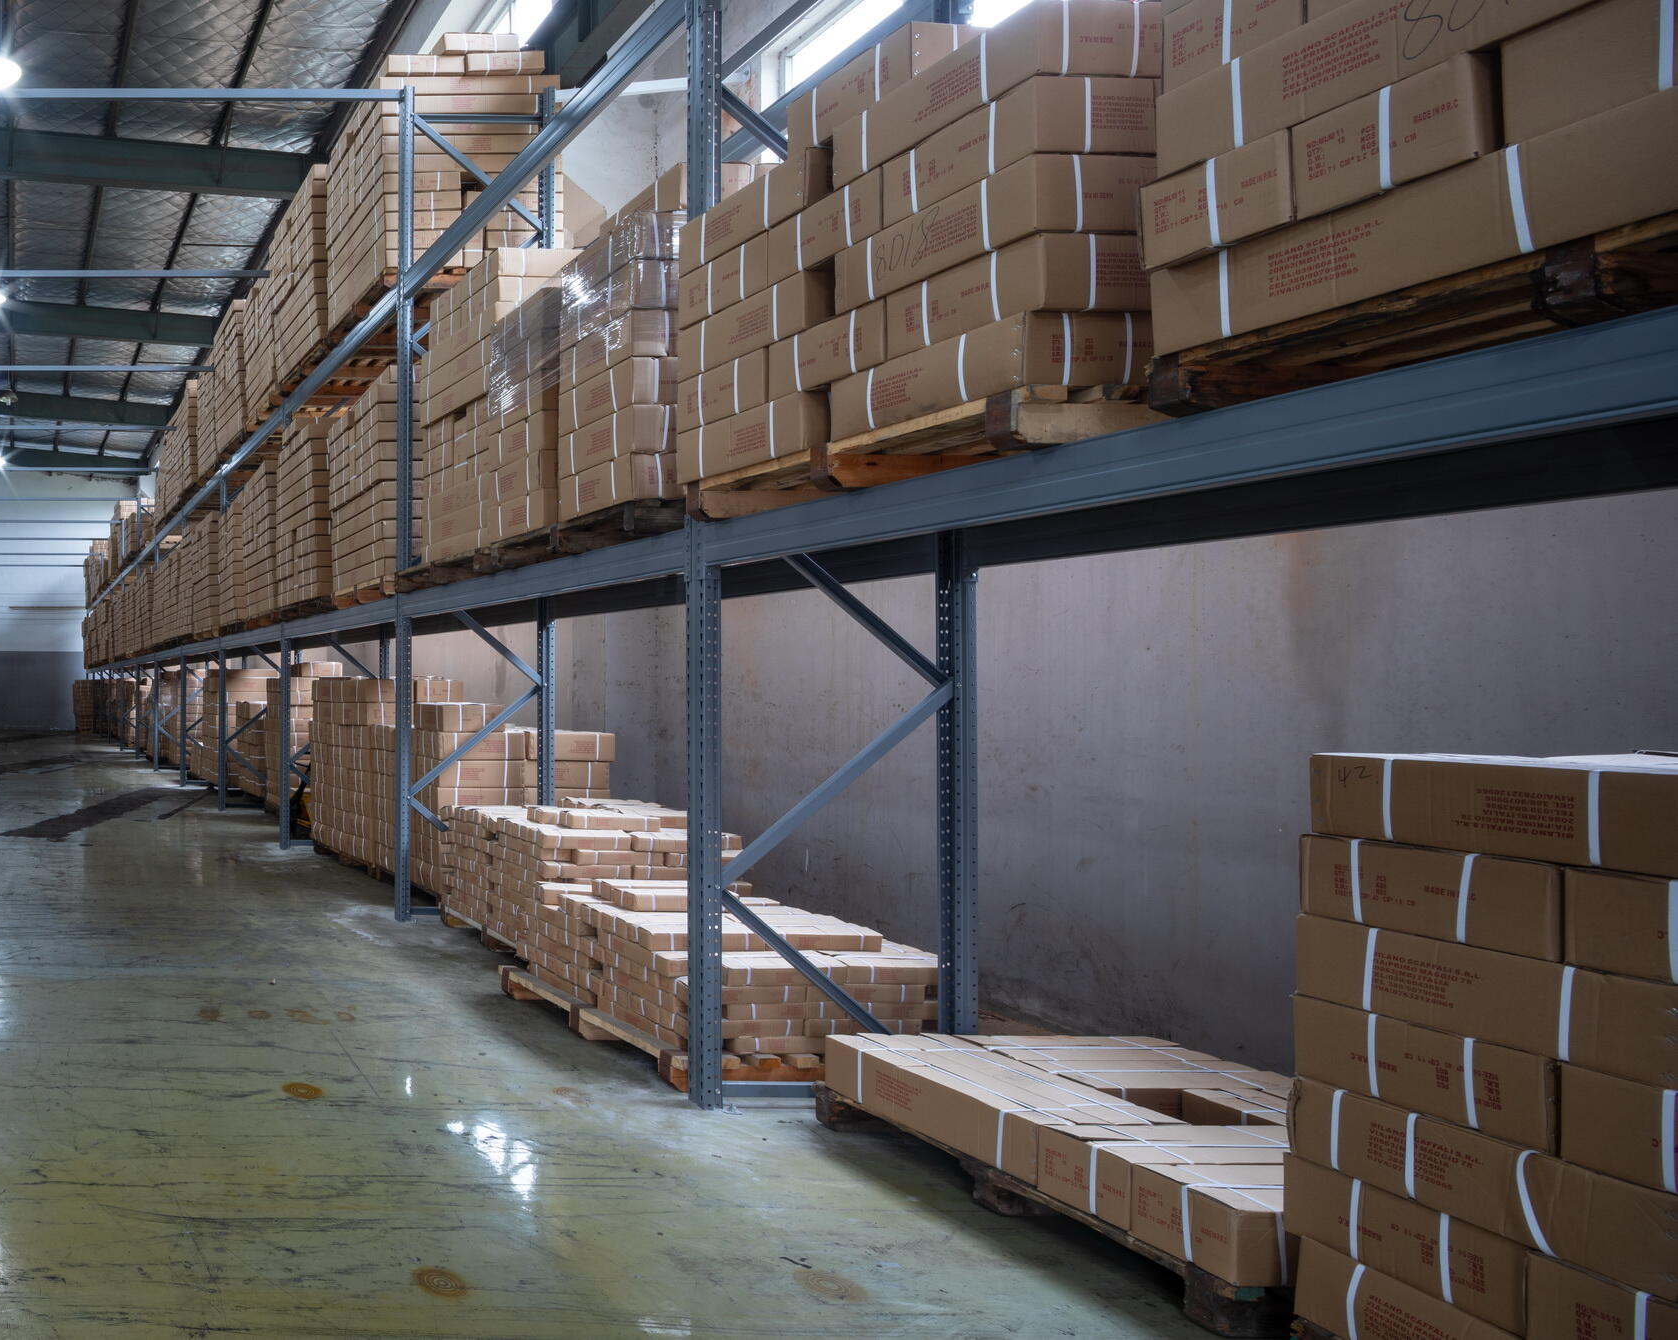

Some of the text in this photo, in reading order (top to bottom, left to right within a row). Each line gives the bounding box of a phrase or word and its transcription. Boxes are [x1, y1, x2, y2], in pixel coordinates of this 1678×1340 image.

[1282, 15, 1376, 63] MILANO SCAFFALI
[1268, 245, 1303, 261] MILANO
[1418, 974, 1449, 987] ITALIA
[1369, 1295, 1403, 1314] MILANO
